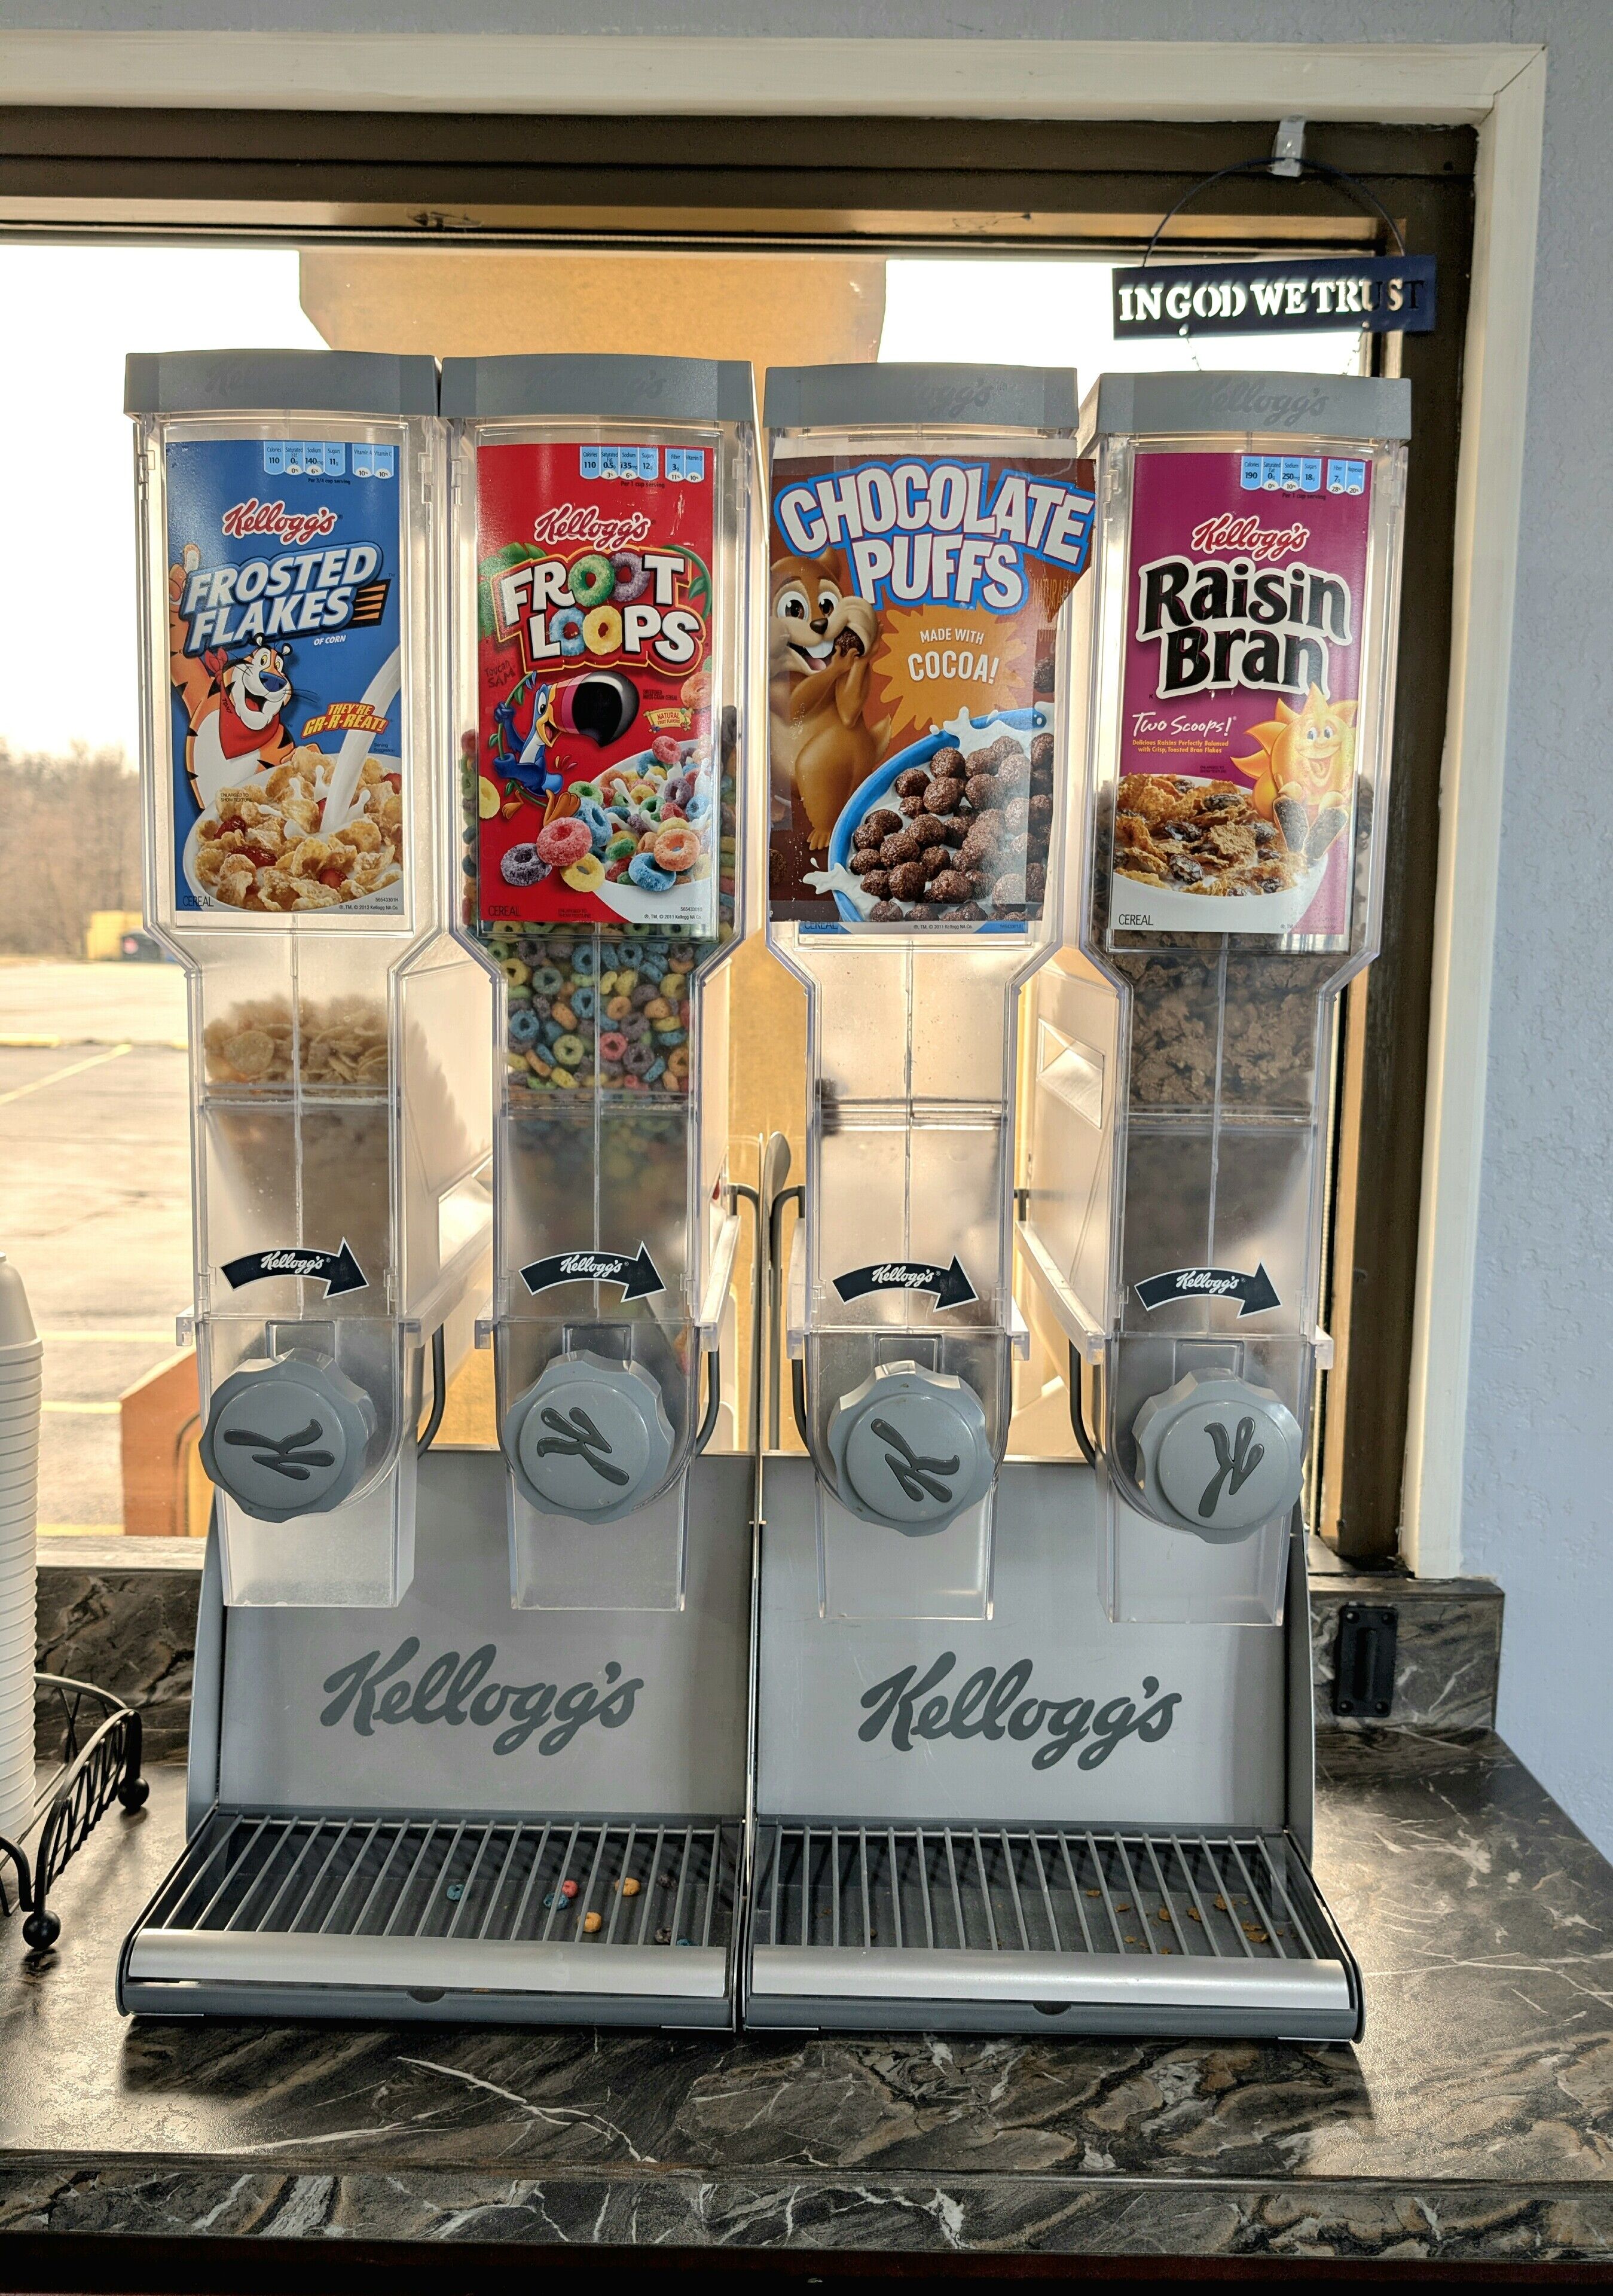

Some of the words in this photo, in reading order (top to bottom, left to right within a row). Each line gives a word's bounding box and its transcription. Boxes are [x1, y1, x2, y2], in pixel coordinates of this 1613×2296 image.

[1119, 286, 1162, 321] IN
[1166, 284, 1246, 319] GOD
[1250, 281, 1307, 316] WE
[1312, 277, 1425, 313] TRUST
[222, 497, 338, 545] Kellogg's
[534, 503, 653, 550] Kellogg's
[780, 465, 1095, 565] CHOCOLATE
[1191, 512, 1310, 561] Kellogg's
[183, 545, 378, 613] FROSTED
[851, 533, 1018, 608] PUFFS
[499, 552, 685, 627] FROOT
[1144, 562, 1348, 643] Raisin
[188, 586, 353, 651] FLAKES
[528, 604, 699, 663] LOOPS
[325, 635, 346, 645] CORN
[919, 628, 952, 644] MADE
[955, 628, 984, 645] WITH
[484, 660, 511, 677] Toucan
[908, 650, 999, 685] COCOA!
[1163, 626, 1330, 694] Bran
[488, 668, 516, 688] SAM
[328, 703, 375, 715] THEY'RE
[1132, 712, 1168, 737] Two
[1170, 715, 1232, 738] Scoops!
[183, 896, 214, 908] CEREAL
[488, 905, 522, 917] CEREAL
[804, 921, 838, 930] CEREAL
[1117, 914, 1154, 926] CEREAL
[261, 1251, 325, 1272] Kellogg's
[560, 1254, 624, 1277] Kellogg's
[872, 1264, 935, 1287] Kellogg's
[1175, 1272, 1240, 1293] Kellogg's
[319, 1636, 644, 1756] Kellogg's
[857, 1651, 1183, 1771] Kellogg's
